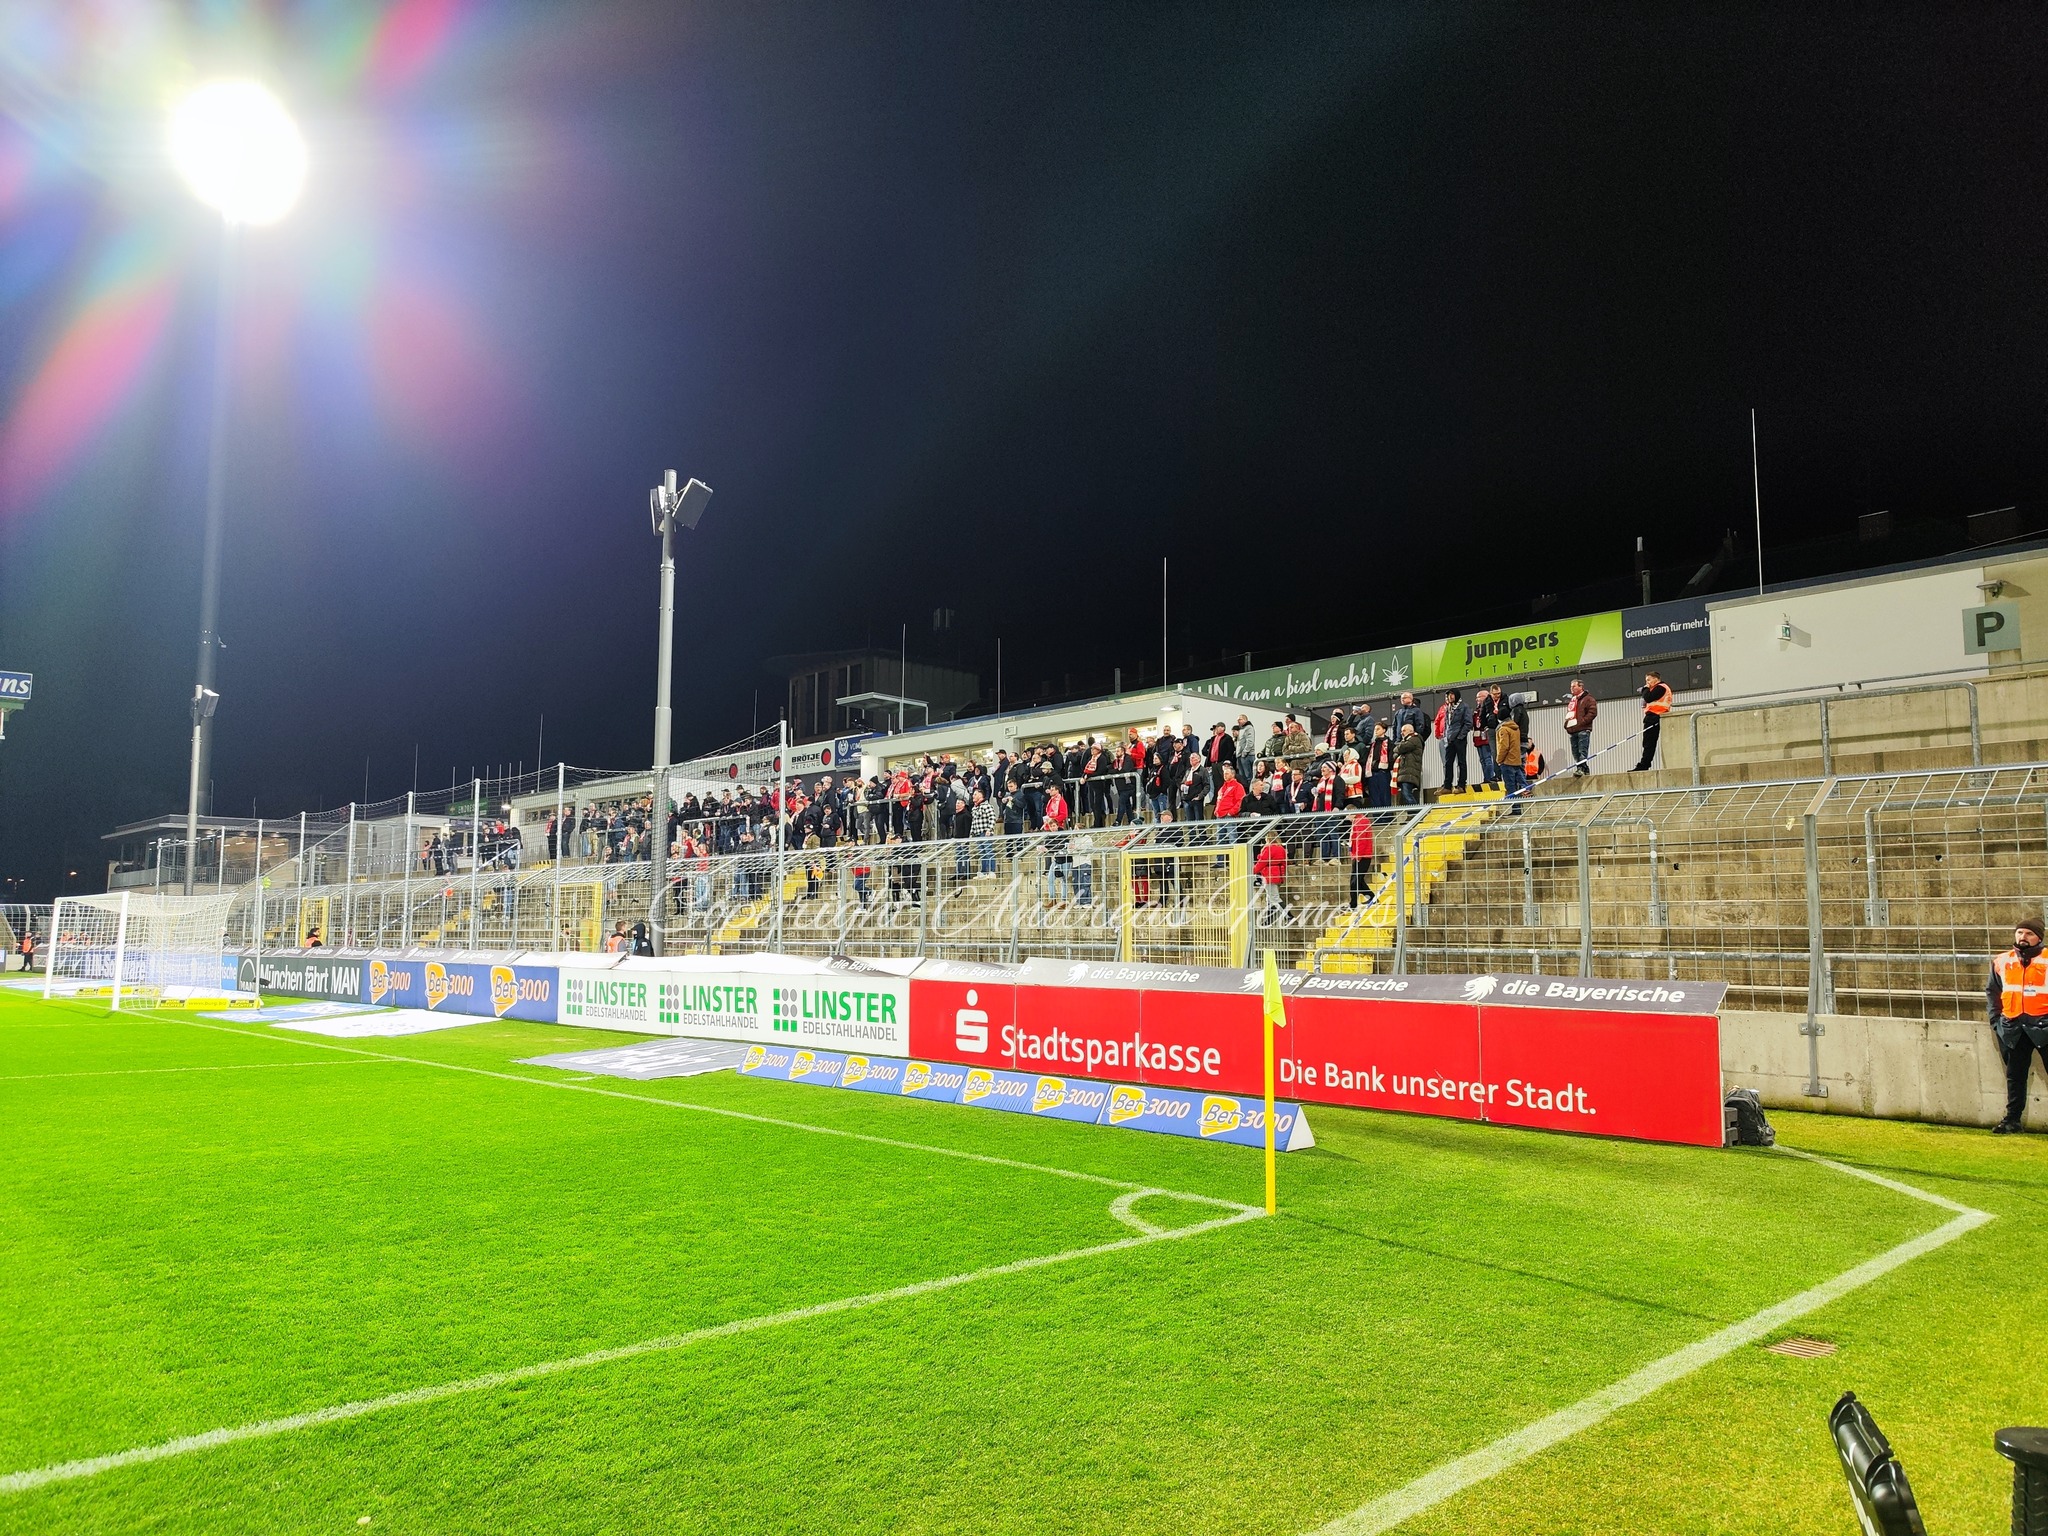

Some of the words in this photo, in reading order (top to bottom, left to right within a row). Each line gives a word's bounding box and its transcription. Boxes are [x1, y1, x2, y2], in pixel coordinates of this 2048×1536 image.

[1625, 625, 1670, 639] Gemeinsam
[1670, 622, 1682, 633] für
[1682, 619, 1704, 631] mehr
[1976, 611, 2005, 647] P
[1465, 631, 1559, 665] jumpers
[1465, 655, 1561, 678] FITNESS
[1274, 686, 1285, 697] a
[1286, 667, 1322, 699] bissl
[1323, 661, 1376, 690] mehr!
[791, 752, 821, 763] BRÖTJE
[791, 761, 821, 770] HEIZUNG
[830, 959, 847, 970] die
[948, 965, 962, 976] die
[1090, 968, 1112, 981] die
[1115, 967, 1200, 984] Bayerische
[261, 963, 302, 992] München
[304, 964, 328, 994] fährt
[331, 966, 360, 996] MAN
[1279, 973, 1301, 986] die
[1305, 976, 1409, 993] Bayerische
[1502, 979, 1541, 996] die
[1544, 982, 1686, 1003] Bayerische
[586, 980, 647, 1008] LINSTER
[683, 984, 758, 1015] LINSTER
[585, 1005, 647, 1022] EDELSTAHLHANDEL
[802, 989, 897, 1024] LINSTER
[683, 1012, 759, 1030] EDELSTAHLHANDEL
[802, 1021, 898, 1042] EDELSTAHLHANDEL
[1000, 1023, 1221, 1076] Stadtsparkasse
[1279, 1058, 1317, 1086] Die
[1324, 1062, 1386, 1094] Bank
[1392, 1073, 1499, 1104] unserer
[1506, 1078, 1597, 1115] Stadt.
